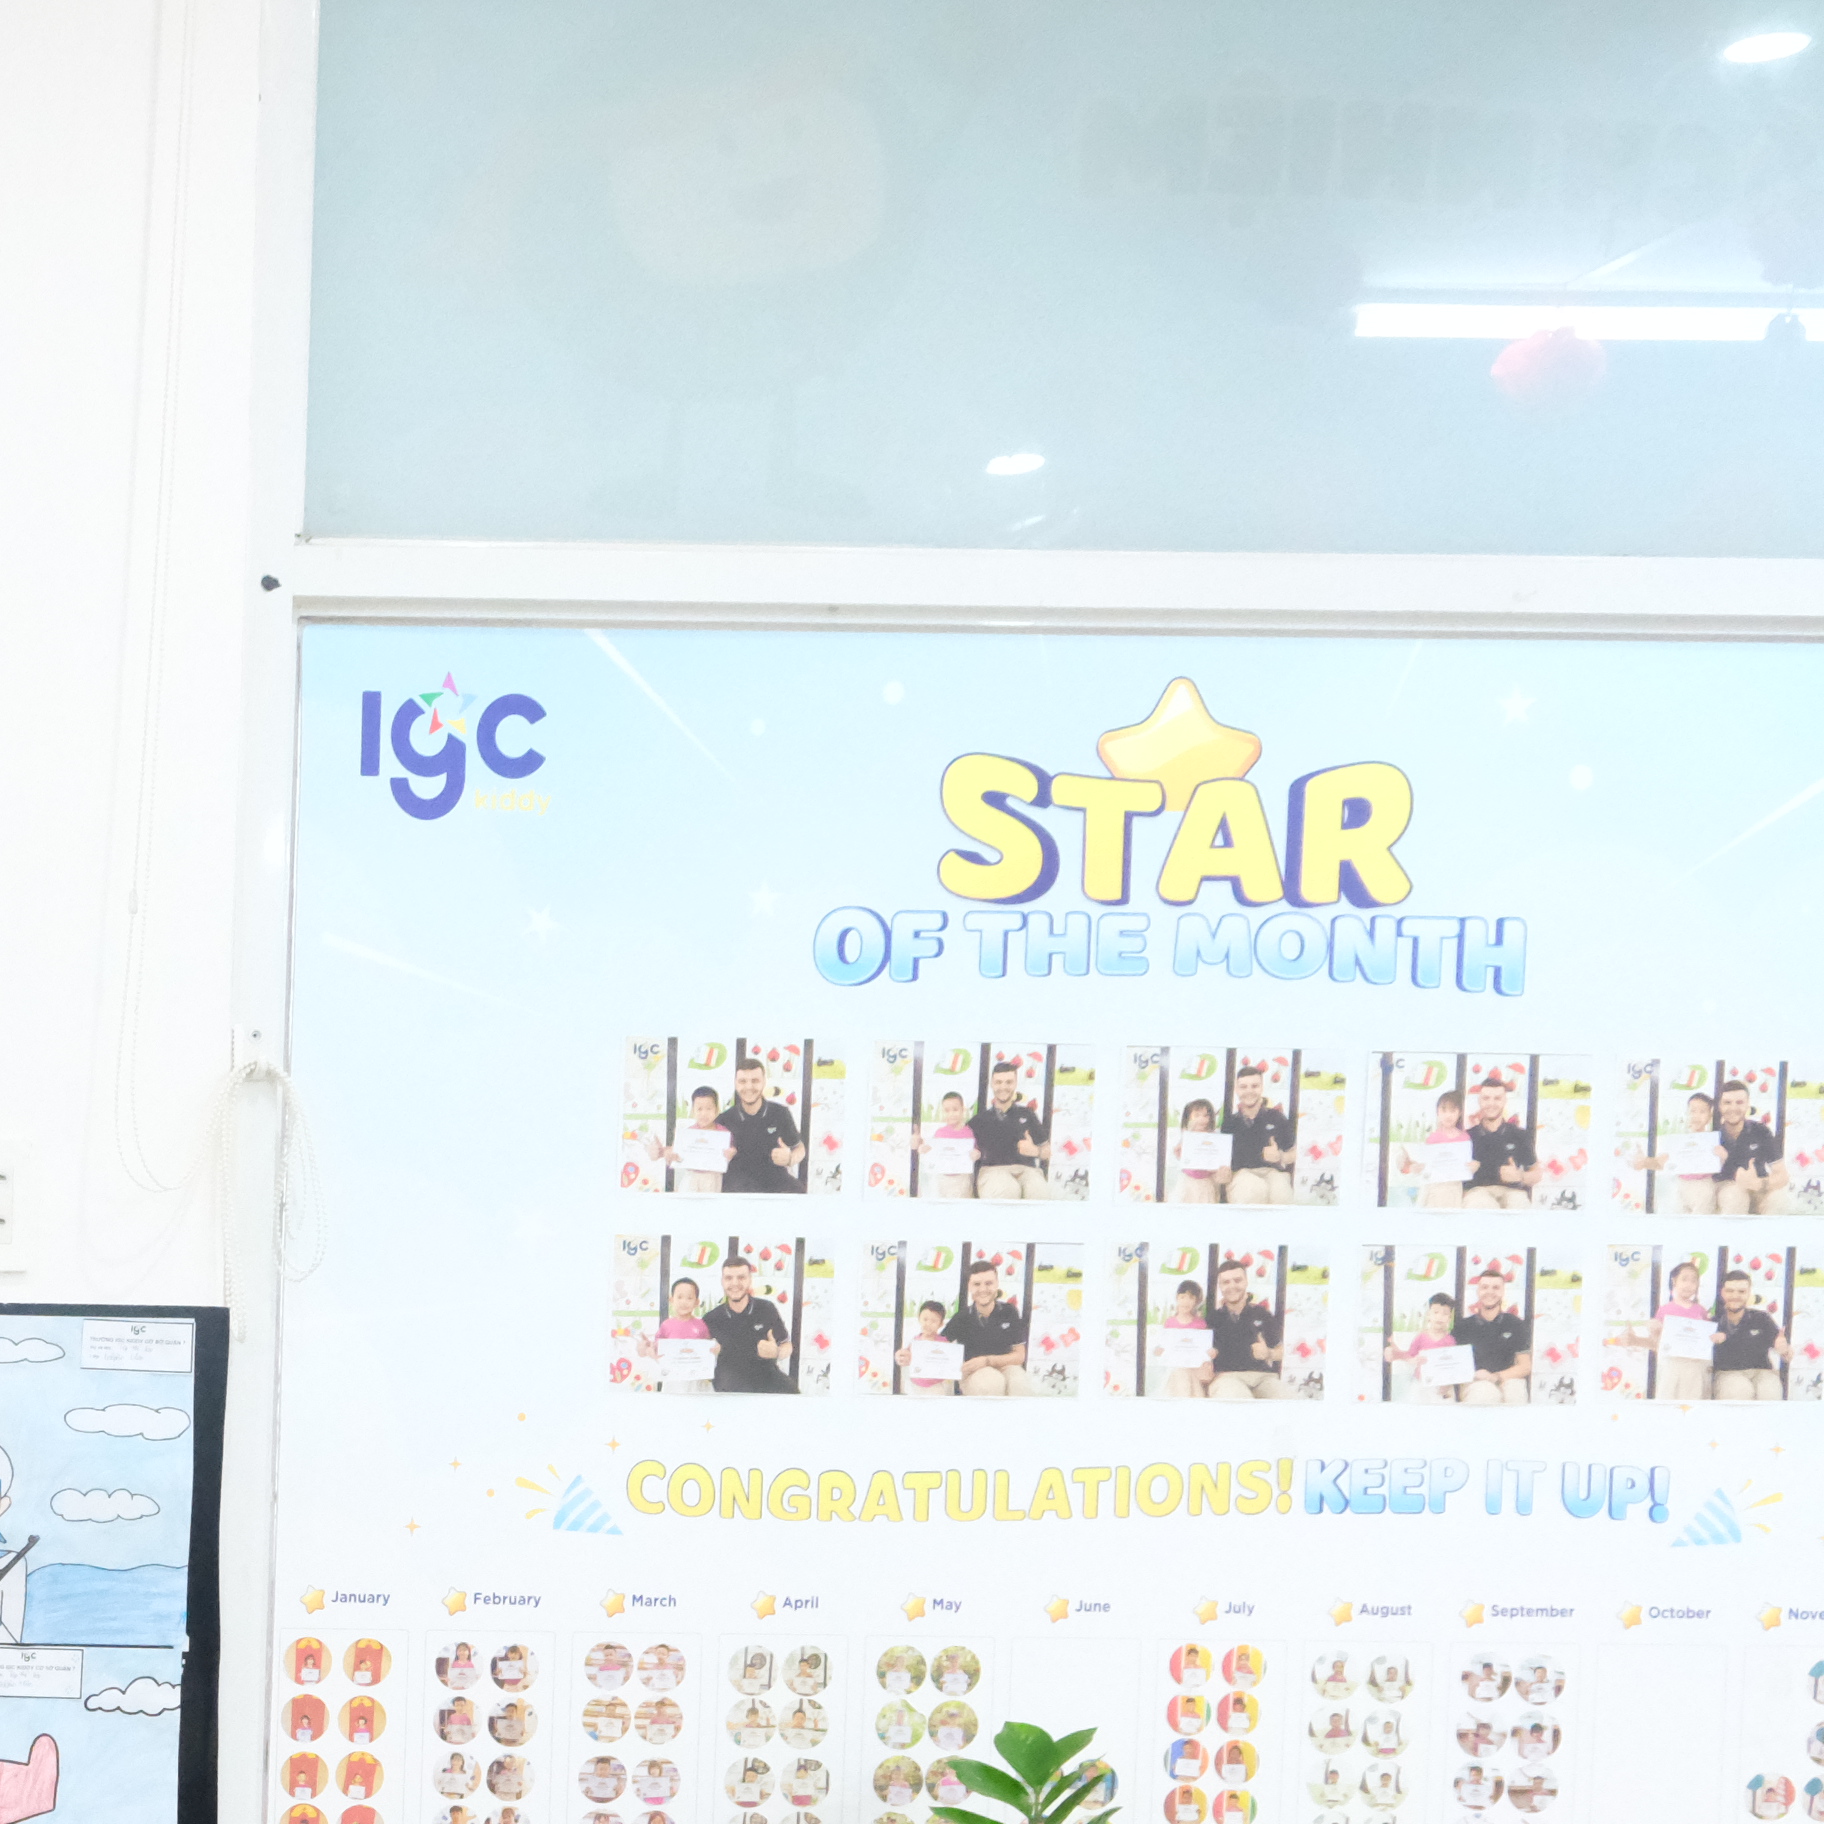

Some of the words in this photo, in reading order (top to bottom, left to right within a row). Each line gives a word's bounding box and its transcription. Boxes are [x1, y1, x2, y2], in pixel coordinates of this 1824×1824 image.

[936, 751, 1415, 911] STAR
[813, 906, 950, 987] OF
[962, 910, 1151, 980] THE
[1172, 909, 1527, 998] MONTH
[625, 1456, 1294, 1525] CONGRATULATIONS!
[1303, 1458, 1466, 1517] KEEP
[1483, 1458, 1542, 1518] IT
[1559, 1461, 1670, 1526] UP!
[332, 1590, 391, 1607] January
[473, 1591, 542, 1609] February
[631, 1593, 677, 1608] March
[782, 1596, 819, 1611] April
[932, 1598, 963, 1614] May
[1074, 1599, 1111, 1614] June
[1224, 1601, 1256, 1617] July
[1359, 1602, 1413, 1619] August
[1490, 1603, 1575, 1621] September
[1648, 1605, 1712, 1620] October
